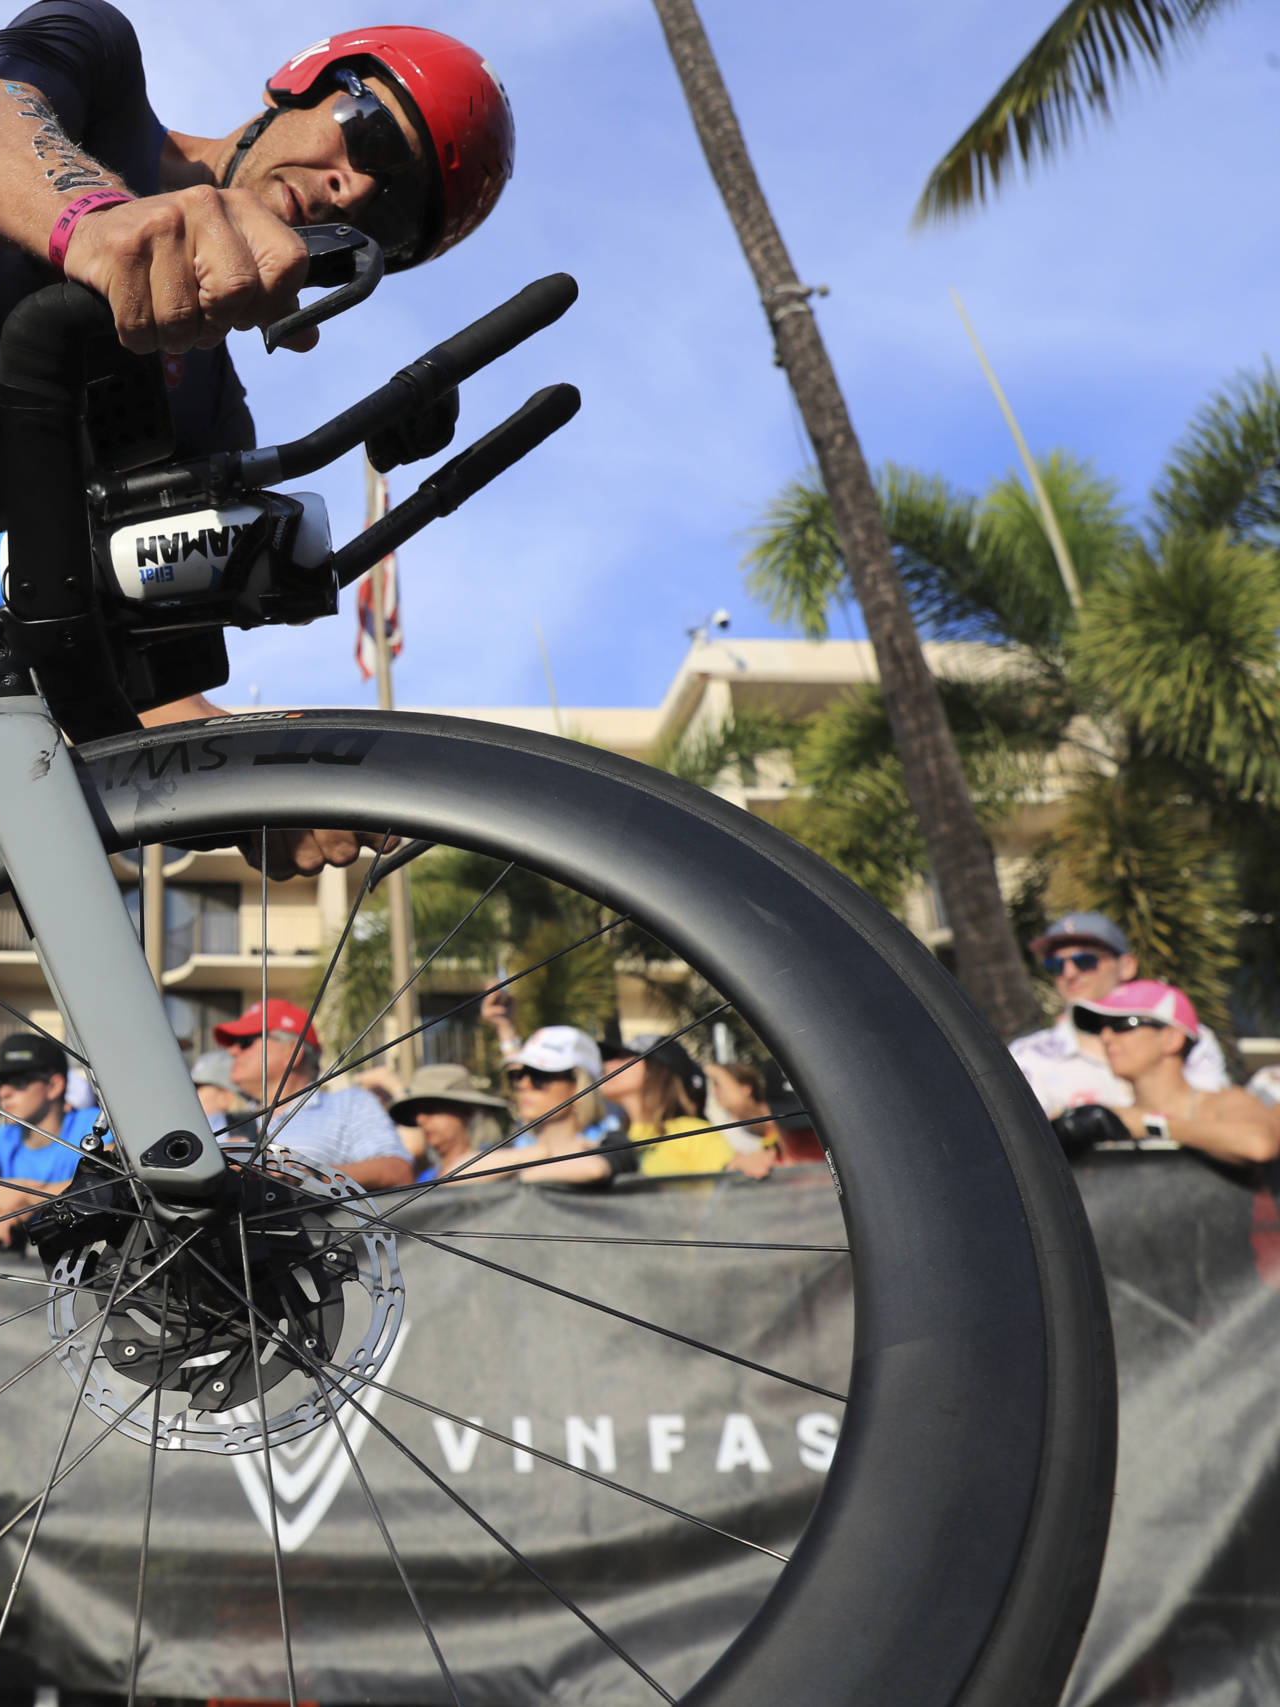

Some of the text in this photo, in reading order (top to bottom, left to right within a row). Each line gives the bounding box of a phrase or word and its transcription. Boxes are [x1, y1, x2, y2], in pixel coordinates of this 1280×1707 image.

[58, 191, 125, 231] HLETE
[136, 523, 254, 567] RAMAN
[140, 565, 175, 584] Eilat
[204, 713, 288, 726] 5000
[105, 735, 233, 791] SWI
[432, 1413, 839, 1473] VINFAS
